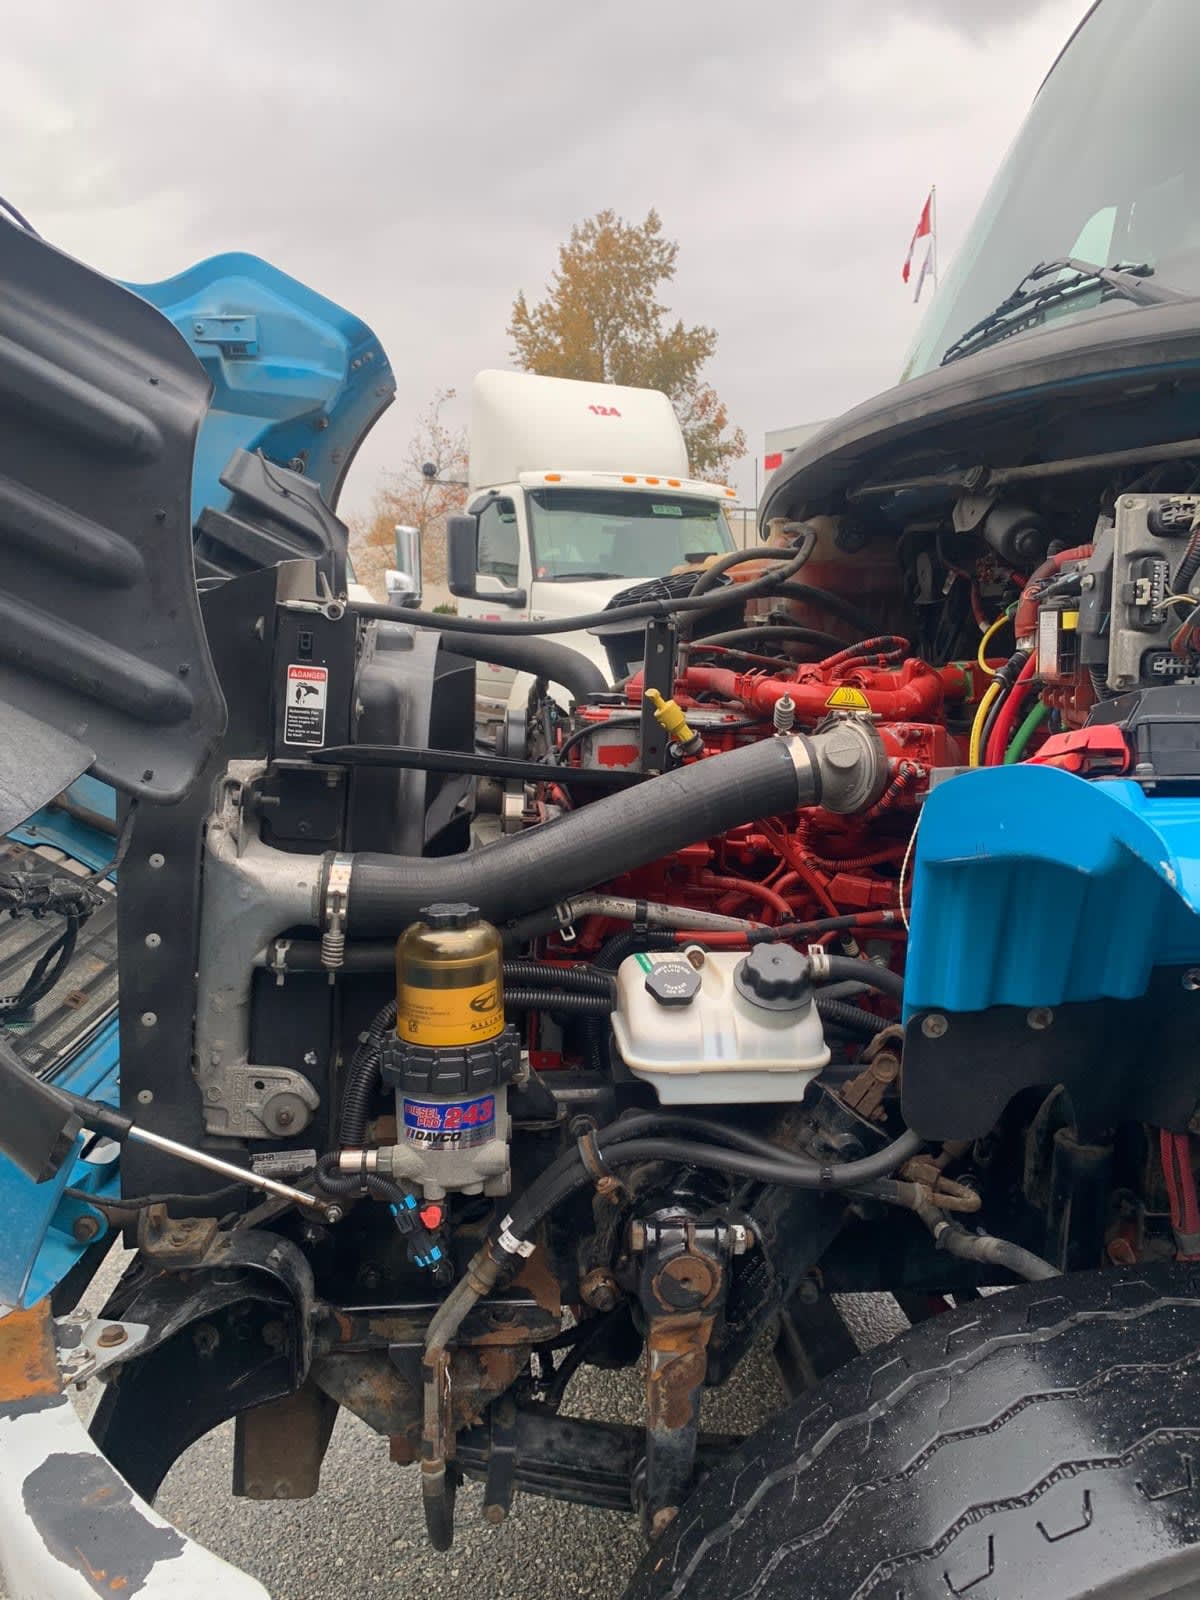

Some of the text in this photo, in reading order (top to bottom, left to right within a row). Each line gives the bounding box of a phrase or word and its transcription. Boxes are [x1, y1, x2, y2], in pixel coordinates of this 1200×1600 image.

[588, 404, 621, 417] 124
[298, 671, 326, 681] DANGER
[404, 1103, 440, 1117] DIESEL
[443, 1099, 494, 1129] 243
[416, 1115, 441, 1129] PRO
[415, 1130, 462, 1142] DAYCO
